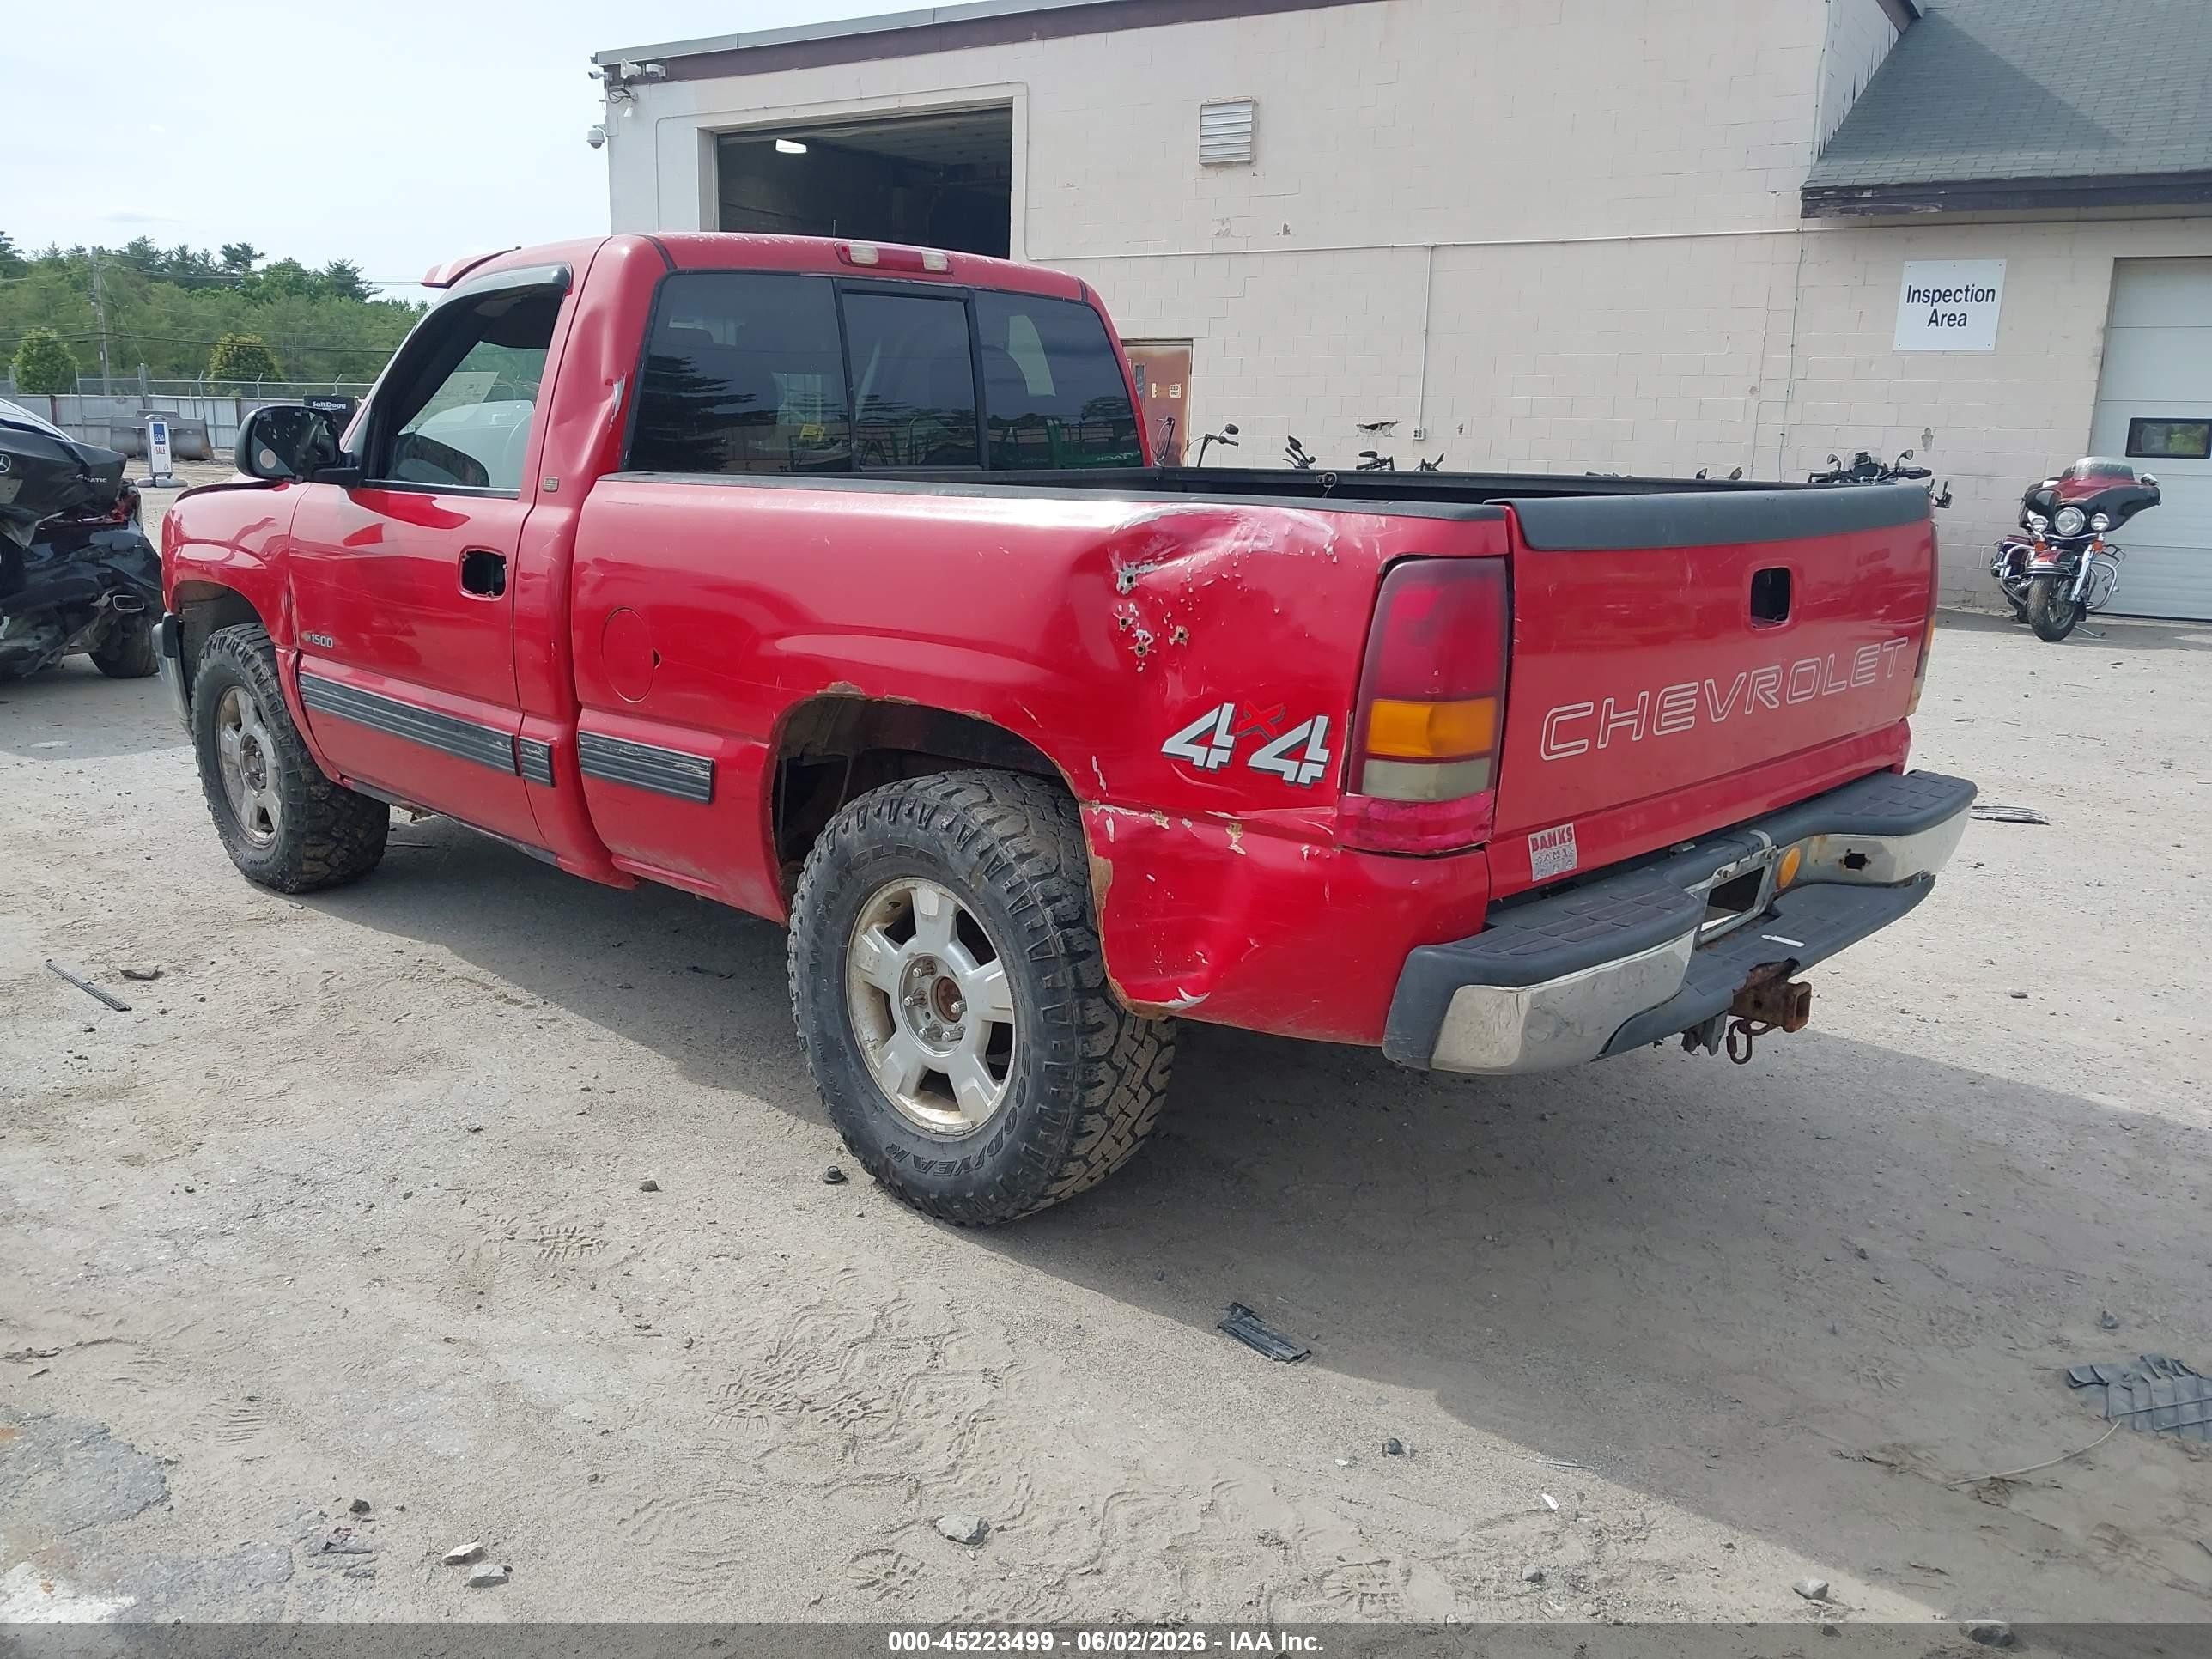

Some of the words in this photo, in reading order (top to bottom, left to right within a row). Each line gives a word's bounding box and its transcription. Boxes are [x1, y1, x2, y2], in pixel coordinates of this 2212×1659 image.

[1906, 283, 1996, 307] Inspection
[1927, 308, 1967, 327] Area
[155, 433, 165, 442] GSA
[311, 633, 333, 648] 1500
[1540, 637, 1909, 761] CHEVROLET
[1529, 826, 1574, 853] BANKS
